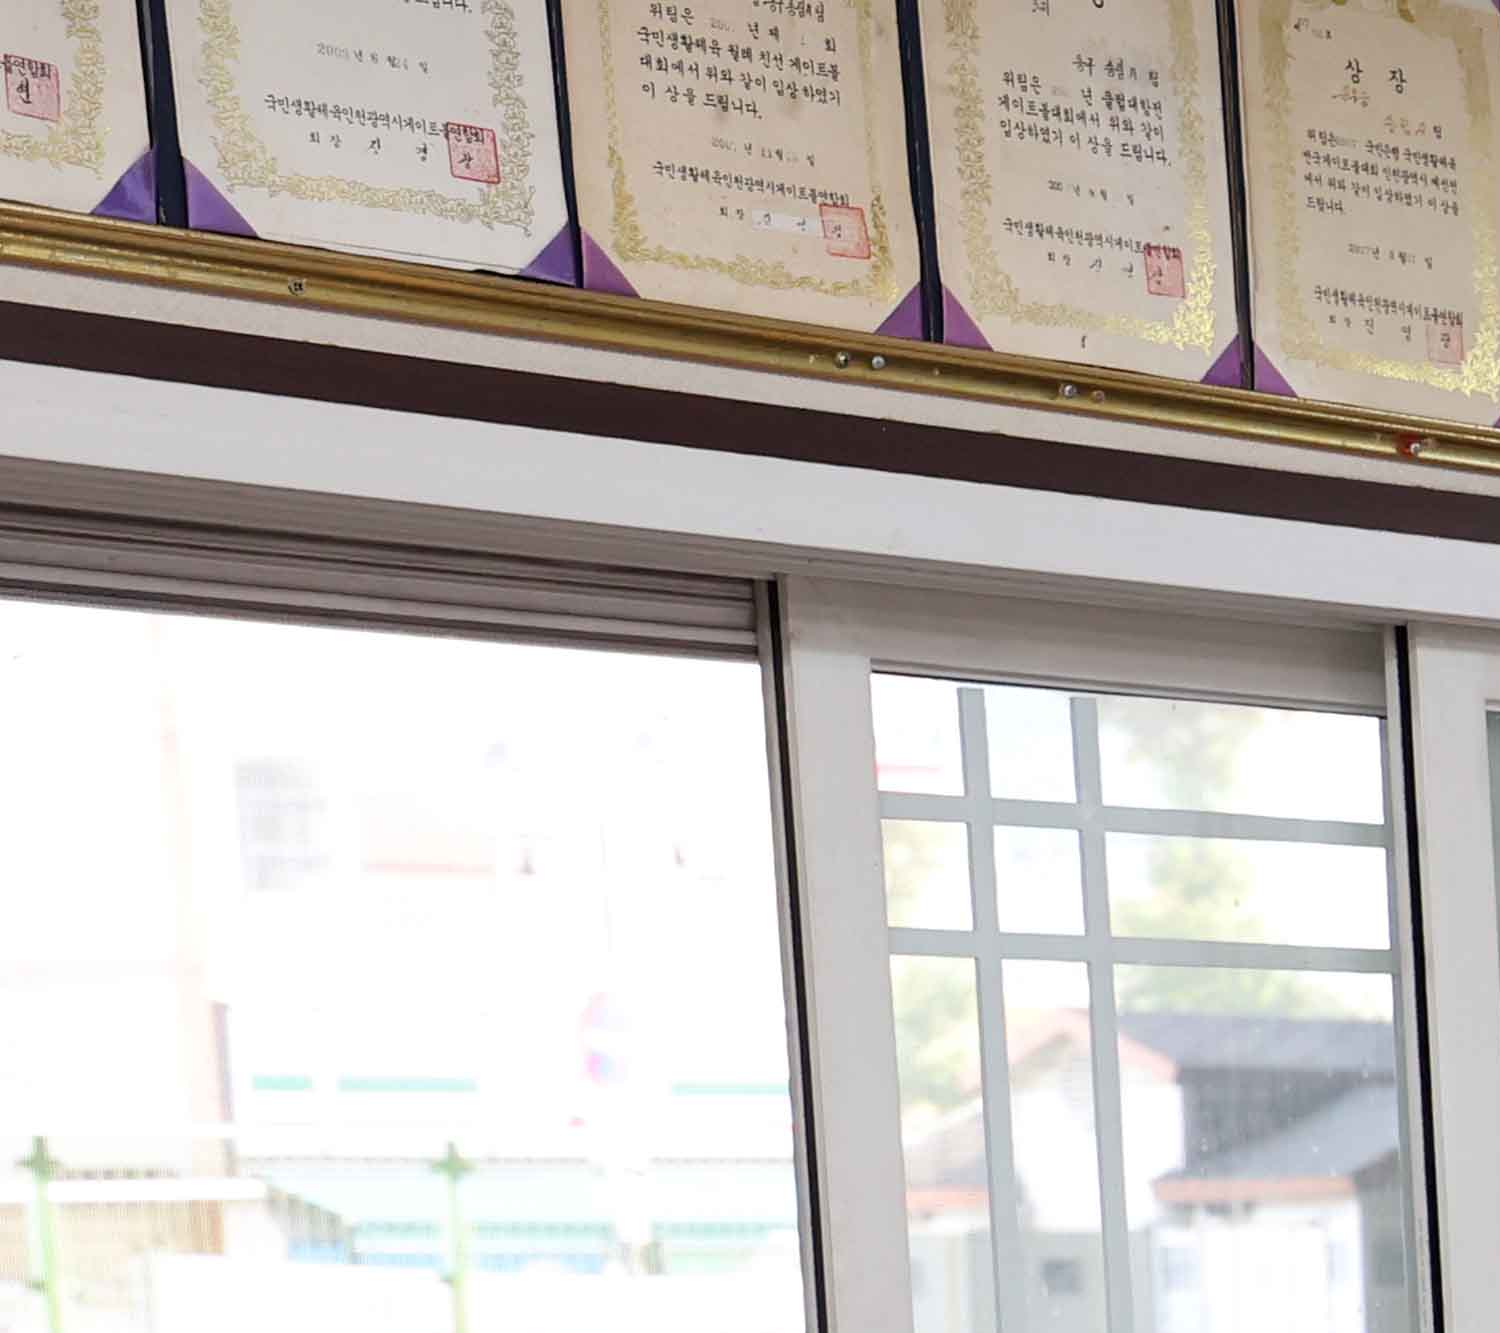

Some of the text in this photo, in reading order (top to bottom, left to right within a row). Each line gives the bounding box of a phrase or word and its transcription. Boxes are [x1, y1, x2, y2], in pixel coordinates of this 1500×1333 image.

[639, 54, 700, 80] 대회에서
[705, 66, 734, 85] 위와
[1344, 57, 1407, 94] 상 장
[642, 81, 656, 99] 이
